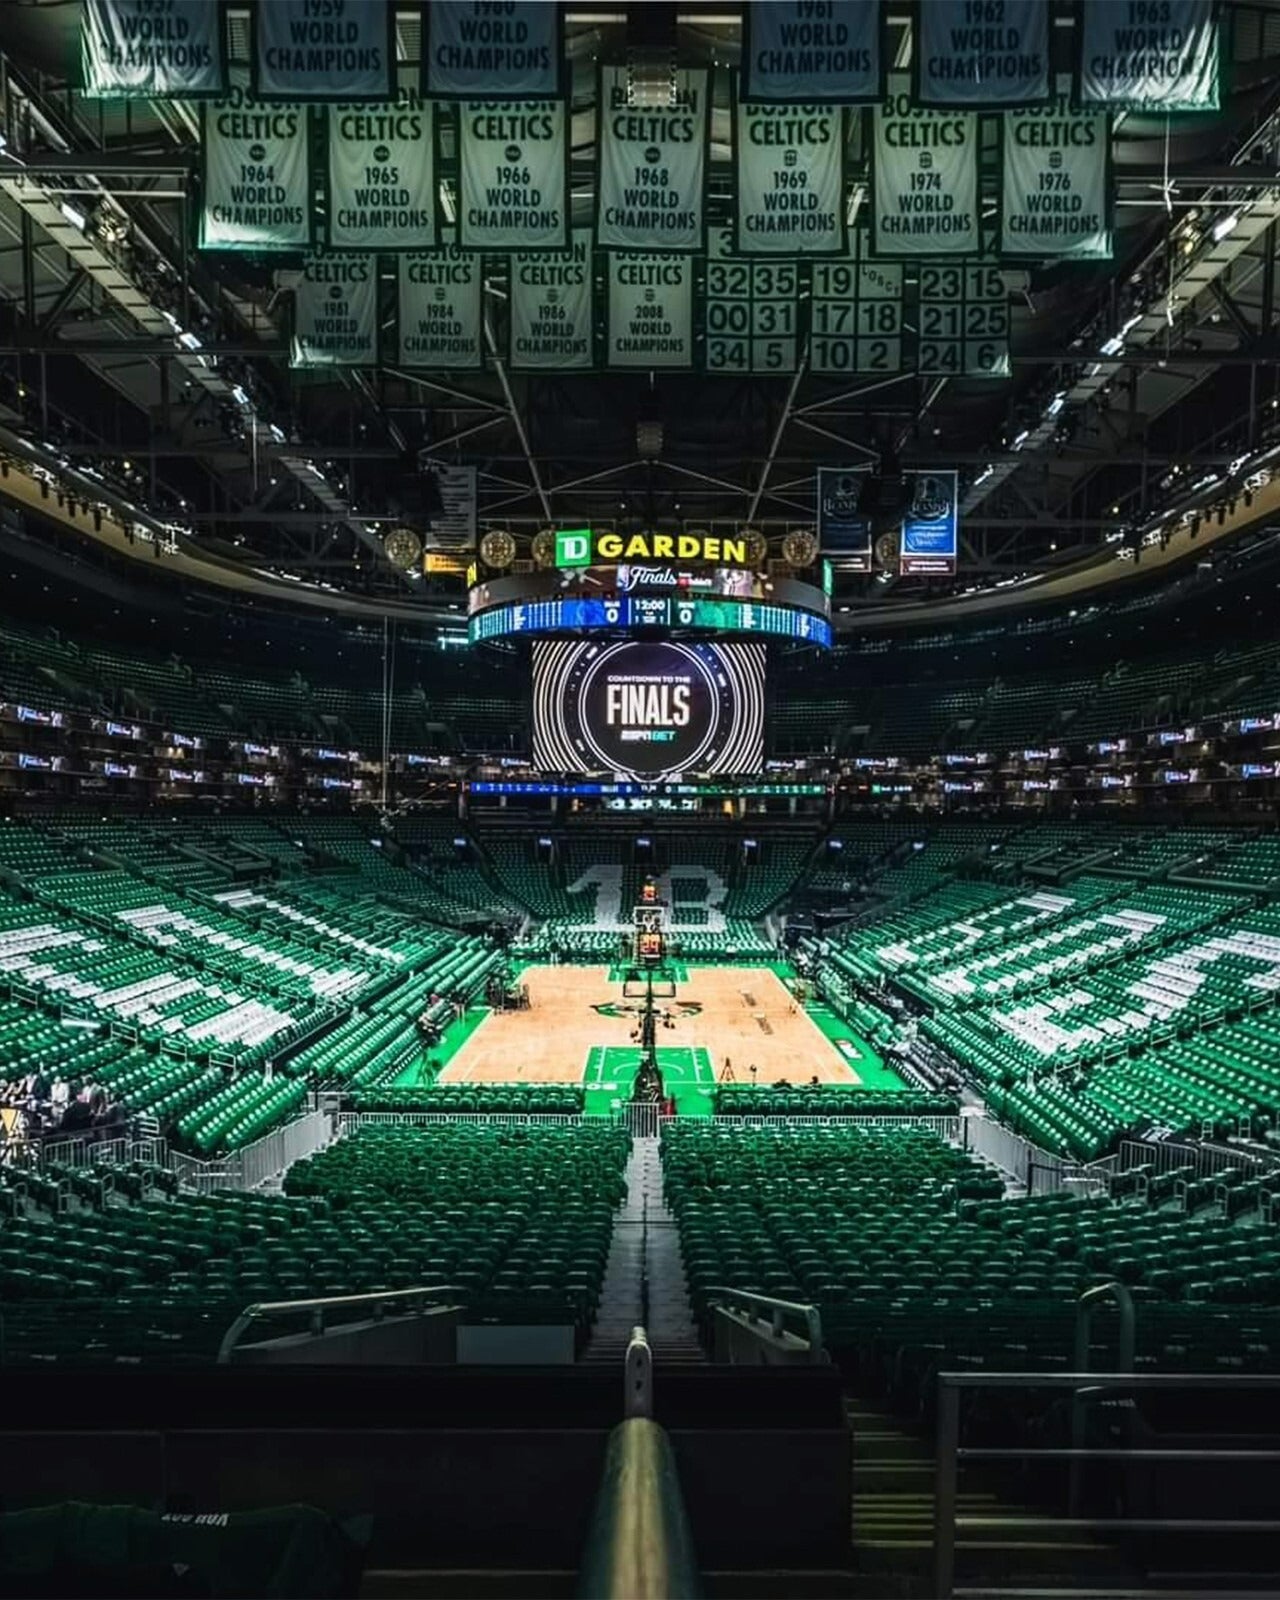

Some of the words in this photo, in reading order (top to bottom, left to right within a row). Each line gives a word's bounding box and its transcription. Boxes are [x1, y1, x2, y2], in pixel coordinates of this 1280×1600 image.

[965, 0, 1005, 24] 1962
[1128, 0, 1171, 24] 1963
[121, 16, 189, 40] WORLD
[290, 20, 359, 44] WORLD
[459, 20, 528, 44] WORLD
[780, 24, 848, 47] WORLD
[951, 27, 1020, 52] WORLD
[1115, 28, 1182, 53] WORLD
[101, 42, 212, 68] HAMPIONS
[265, 48, 382, 73] CHAMPIONS
[437, 45, 553, 71] CHAMPIONS
[757, 49, 871, 74] CHAMPIONS
[928, 54, 1041, 80] CHAMPIONS
[1090, 55, 1194, 79] CHAMPION
[217, 113, 298, 139] CELTICS
[340, 115, 422, 141] CELTICS
[472, 115, 554, 141] CELTICS
[612, 115, 694, 143] CELTICS
[749, 118, 831, 145] CELTICS
[885, 120, 966, 147] CELTICS
[1015, 121, 1096, 147] CELTICS
[240, 164, 274, 183] 1964
[365, 166, 399, 185] 1965
[495, 166, 531, 185] 1966
[634, 167, 669, 187] 1968
[773, 171, 808, 189] 1969
[909, 172, 942, 191] 1974
[1038, 172, 1072, 191] 1976
[230, 186, 286, 204] WORLD
[353, 188, 411, 207] WORLD
[485, 188, 541, 207] WORLD
[624, 189, 680, 208] WORLD
[762, 192, 819, 212] WORLD
[898, 194, 955, 213] WORLD
[1027, 194, 1083, 213] WORLD
[212, 204, 303, 225] CHAMPIONS
[337, 207, 429, 230] CHAMPIONS
[467, 207, 559, 230] CHAMPIONS
[605, 207, 697, 230] CHAMPIONS
[745, 213, 836, 234] CHAMPIONS
[881, 214, 972, 236] CHAMPIONS
[1009, 213, 1100, 235] CHAMPIONS
[304, 262, 369, 284] CELTICS
[408, 262, 472, 285] CELTICS
[520, 263, 584, 286] CELTICS
[618, 263, 683, 286] CELTICS
[710, 267, 747, 294] 32
[755, 267, 794, 295] 35
[816, 267, 851, 294] 19
[922, 270, 960, 298] 23
[970, 270, 1005, 298] 15
[324, 302, 349, 316] 1981
[427, 304, 453, 319] 1984
[538, 305, 566, 320] 1986
[636, 305, 664, 319] 2008
[709, 304, 748, 331] 00
[759, 305, 792, 332] 31
[816, 304, 850, 332] 17
[862, 304, 896, 332] 18
[923, 307, 958, 334] 21
[967, 307, 1006, 334] 25
[314, 319, 358, 333] WORLD
[418, 321, 462, 335] WORLD
[530, 322, 574, 337] WORLD
[629, 321, 672, 335] WORLD
[404, 337, 476, 353] CHAMPIONS
[516, 338, 587, 354] CHAMPIONS
[615, 337, 684, 353] CHAMPIONS
[710, 342, 747, 368] 34
[766, 342, 783, 369] 5
[815, 342, 850, 369] 10
[870, 342, 888, 369] 2
[921, 343, 958, 371] 24
[978, 343, 996, 370] 6
[558, 536, 588, 560] TD
[598, 534, 746, 563] GARDEN
[626, 566, 677, 591] Finals
[606, 608, 619, 623] 0
[634, 600, 666, 611] 12:00
[679, 609, 692, 624] 0
[607, 684, 690, 726] FINALS
